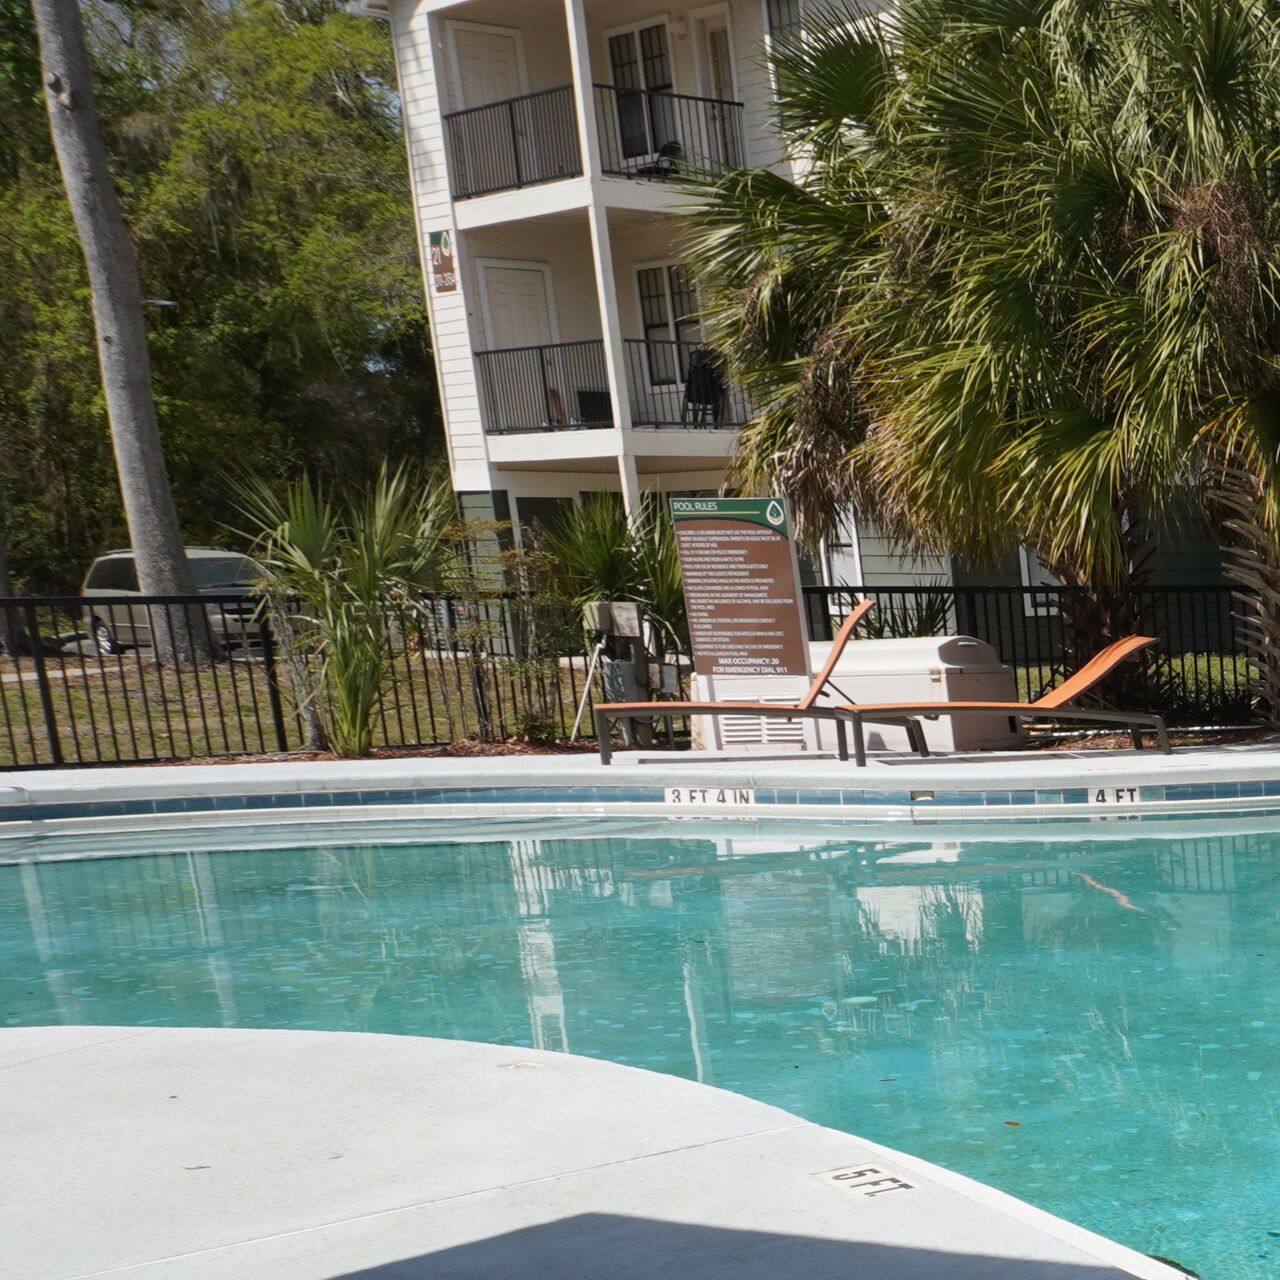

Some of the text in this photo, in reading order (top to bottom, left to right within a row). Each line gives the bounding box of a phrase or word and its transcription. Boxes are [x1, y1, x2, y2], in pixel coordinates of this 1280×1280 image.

[673, 502, 718, 511] POOL RULES
[672, 789, 750, 804] 3 FT 4 IN
[1096, 788, 1137, 803] 4 FT
[832, 1167, 882, 1181] 5
